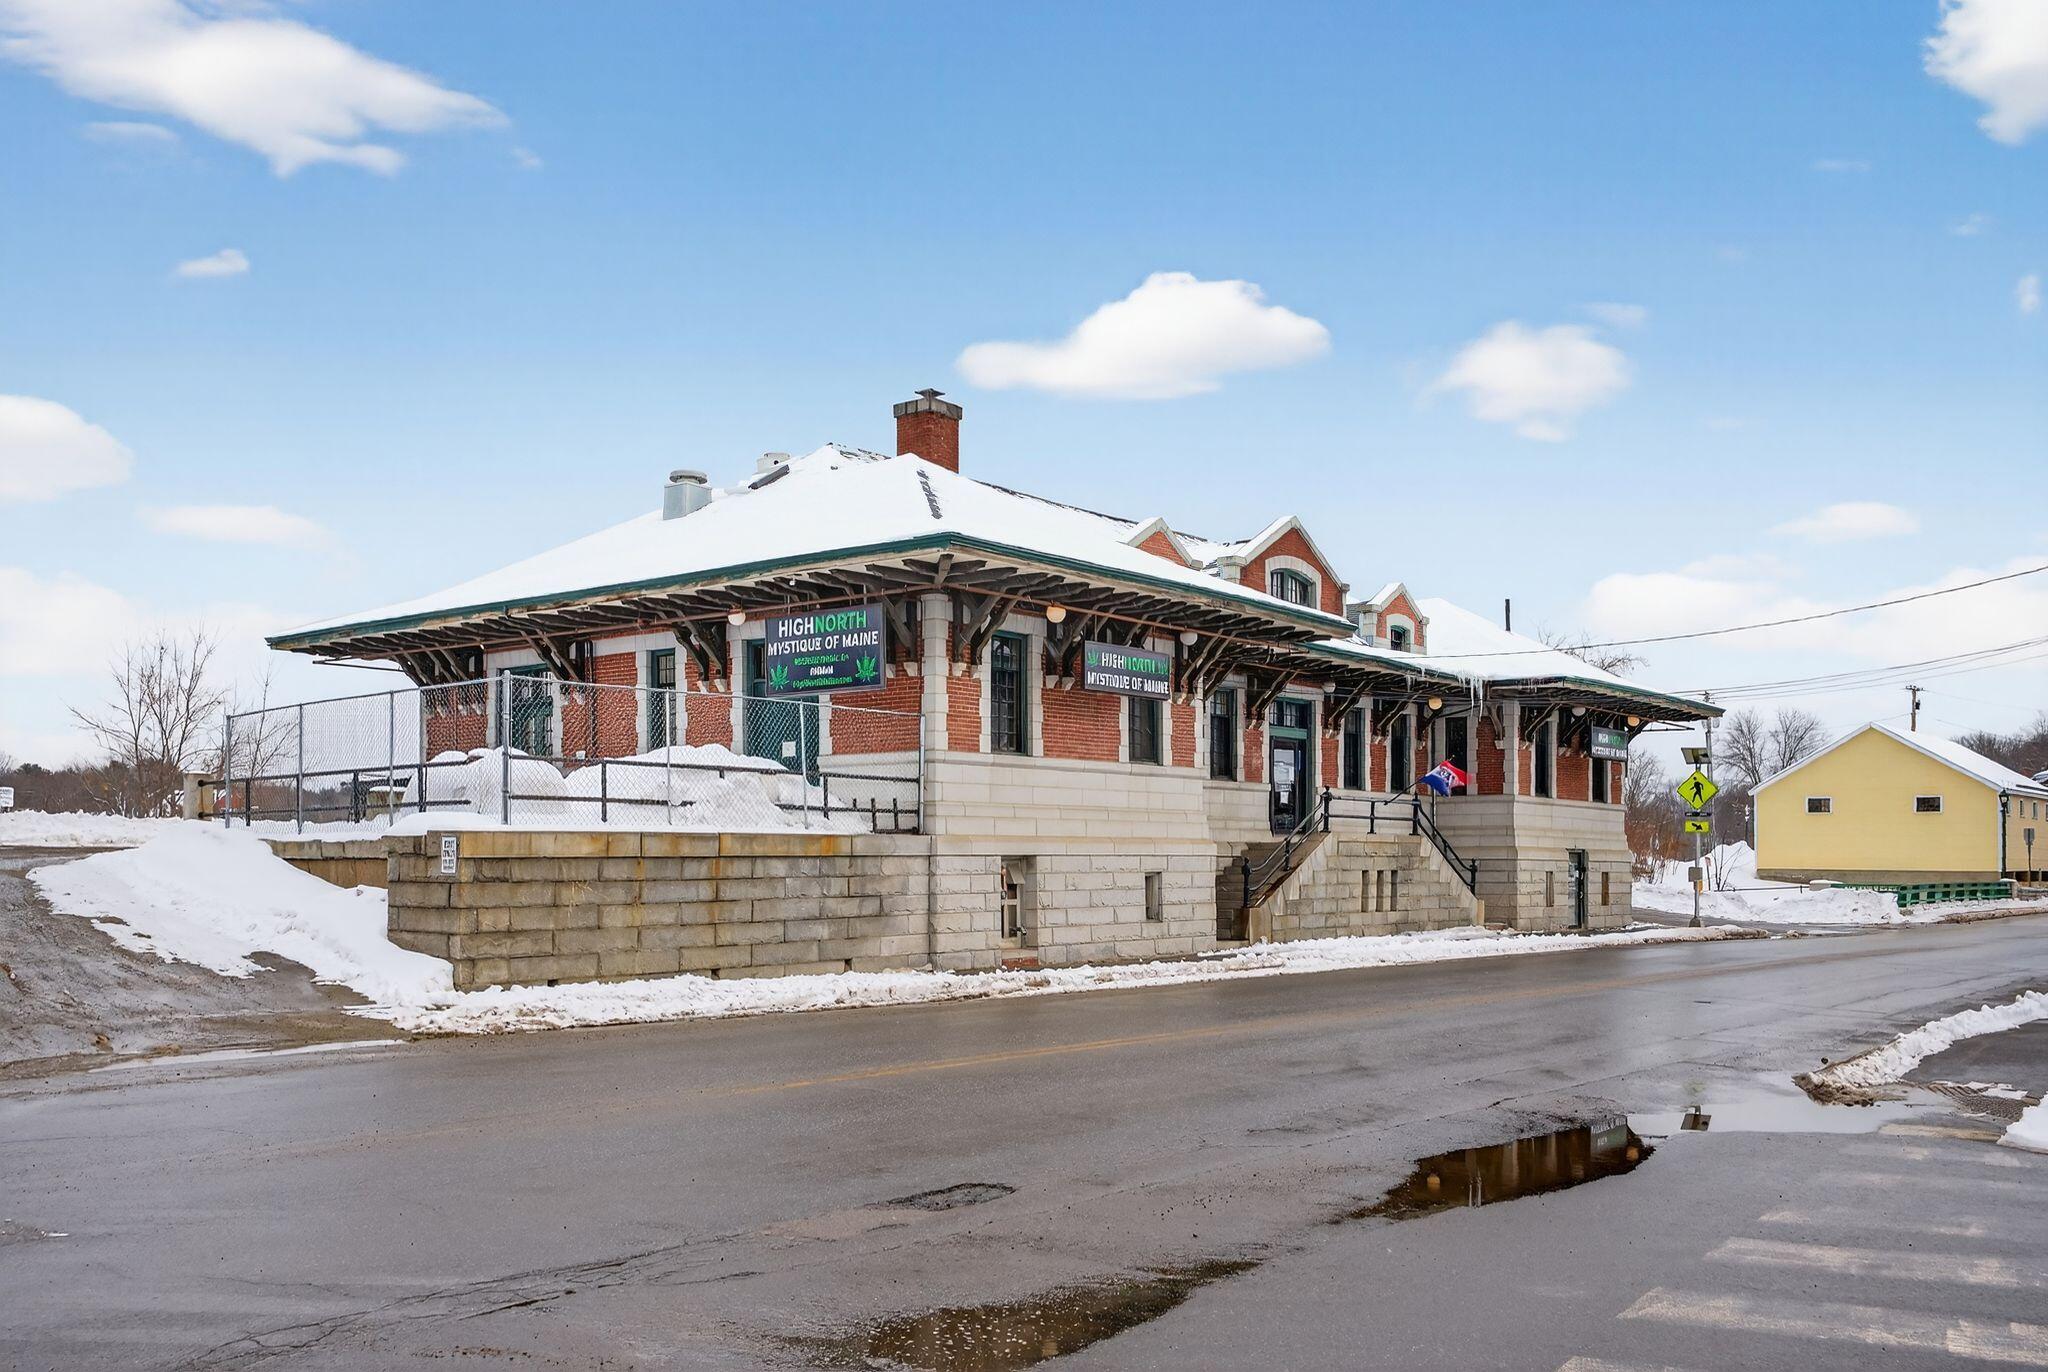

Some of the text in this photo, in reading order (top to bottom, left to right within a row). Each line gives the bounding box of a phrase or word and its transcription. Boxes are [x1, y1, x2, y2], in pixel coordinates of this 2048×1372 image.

[767, 631, 879, 656] MYSTIQUE OF MAINE
